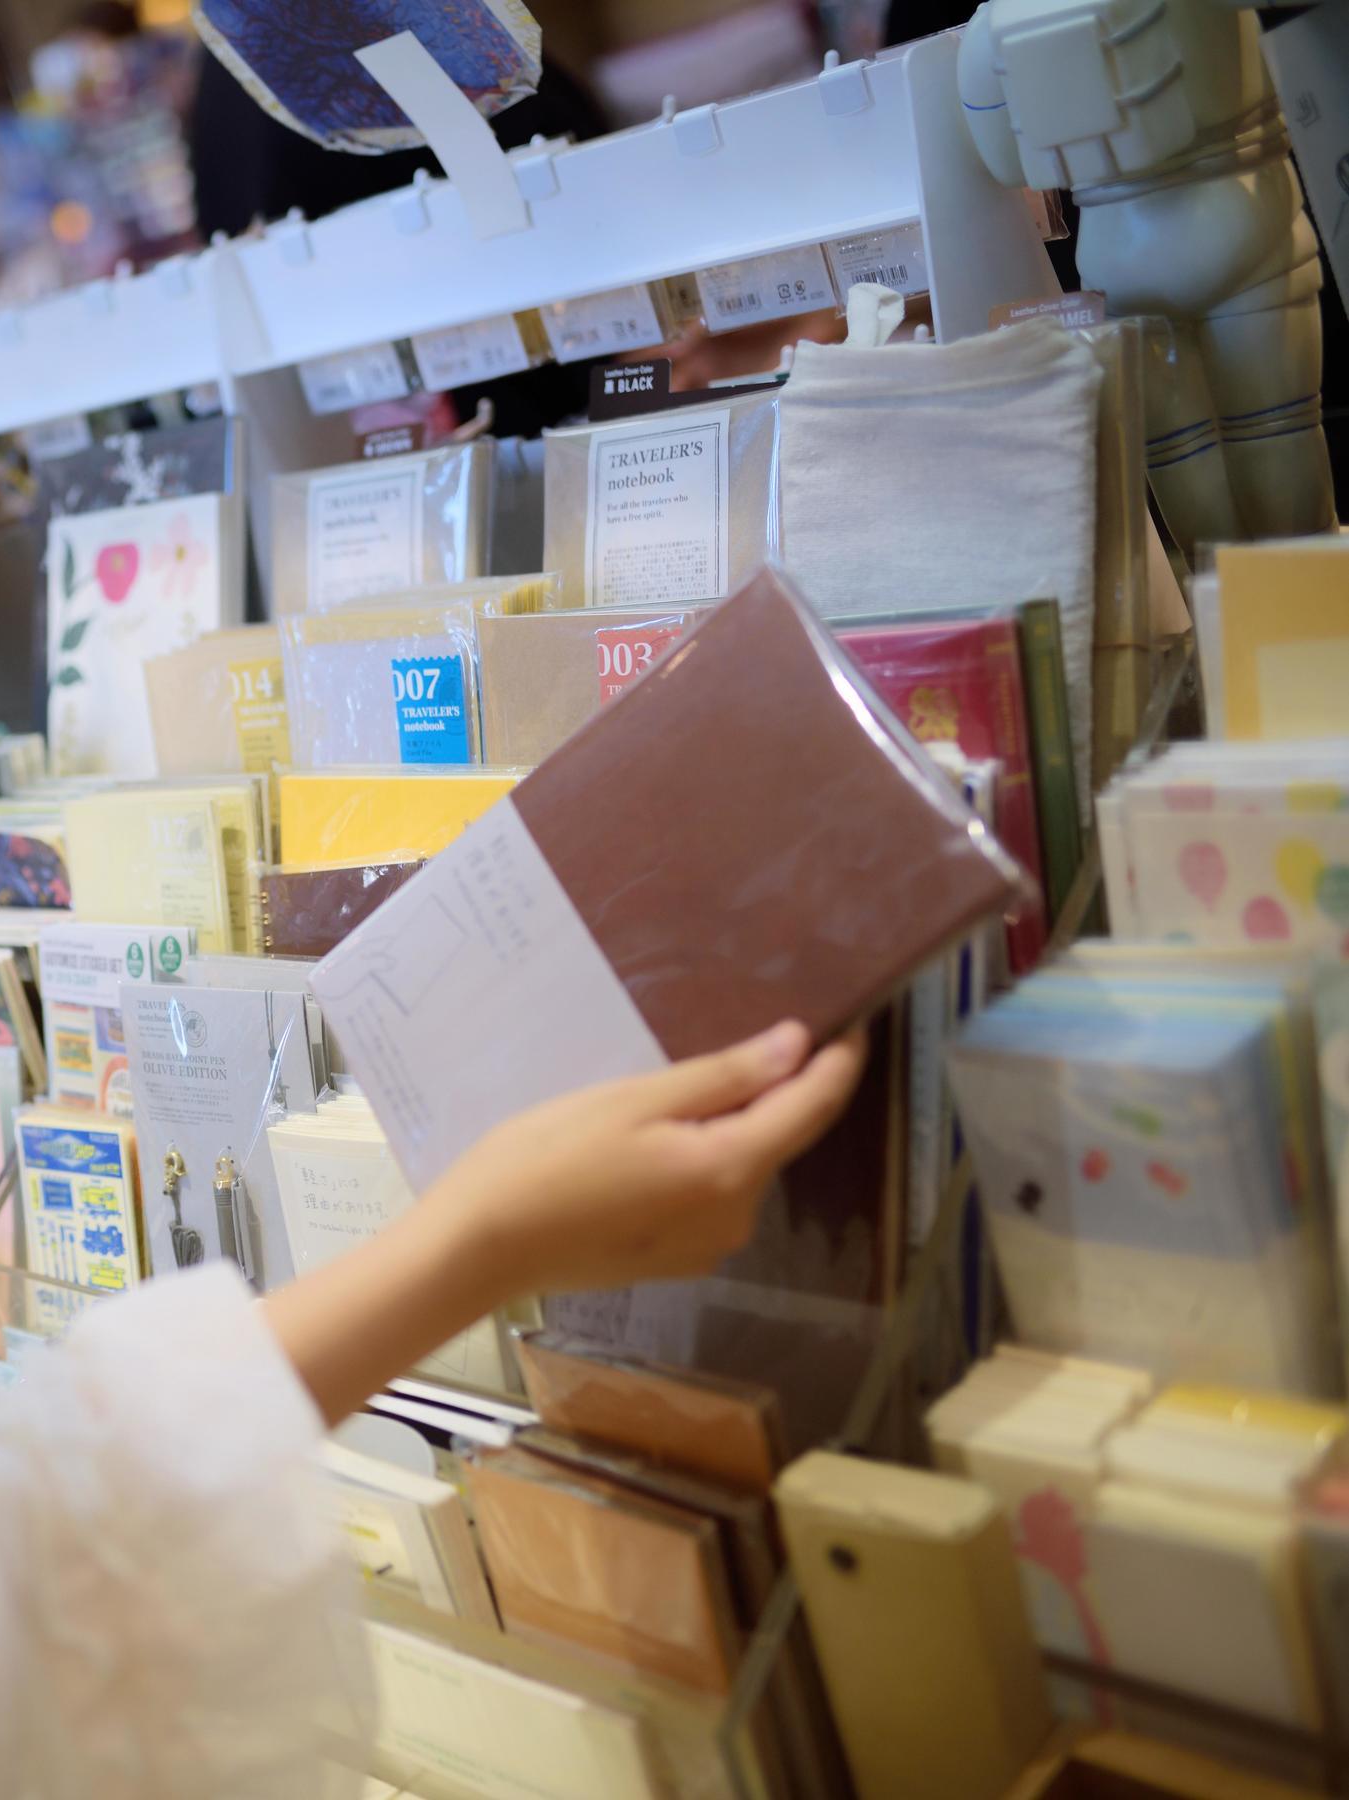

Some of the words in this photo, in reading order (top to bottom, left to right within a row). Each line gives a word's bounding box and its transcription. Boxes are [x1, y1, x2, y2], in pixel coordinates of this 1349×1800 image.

[1059, 309, 1095, 329] MEL
[618, 375, 654, 393] BLACK
[609, 441, 704, 469] TRAVELER'S
[607, 467, 675, 491] notebook
[402, 705, 460, 718] TRAVELER'S
[404, 719, 445, 732] notebook
[210, 1056, 226, 1065] PEN
[143, 1062, 177, 1077] OLIVE
[179, 1065, 227, 1081] EDITION
